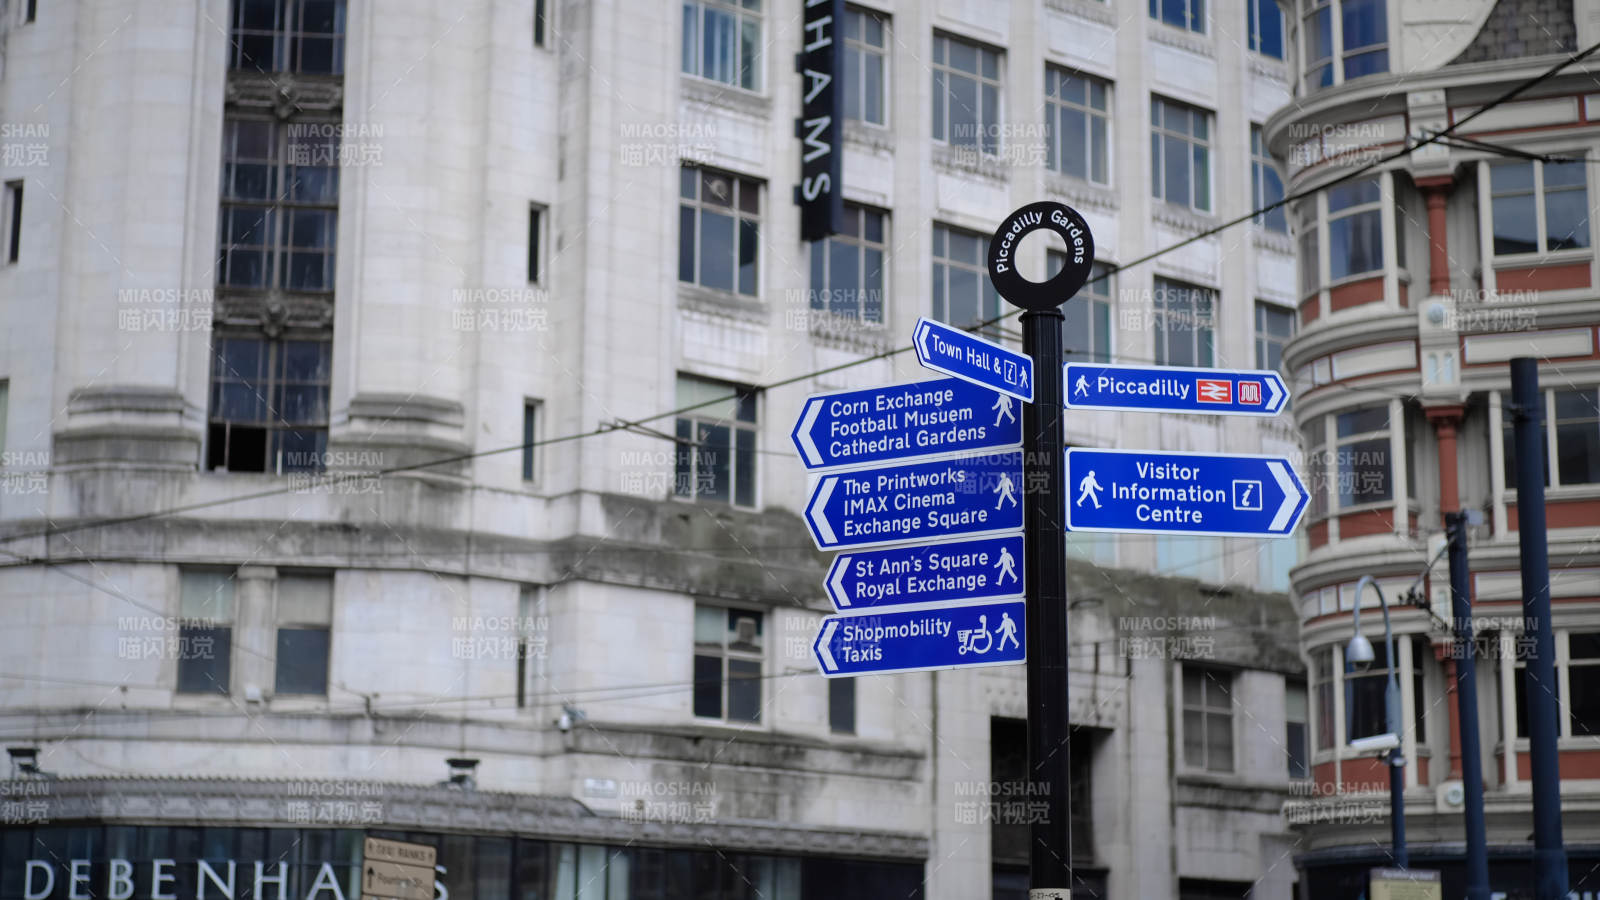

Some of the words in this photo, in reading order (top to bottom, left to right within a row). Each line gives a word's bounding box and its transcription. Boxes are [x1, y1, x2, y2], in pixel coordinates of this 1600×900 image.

[803, 0, 832, 201] HAMS
[996, 211, 1042, 273] Piccadilly
[1051, 210, 1084, 264] Gardens
[932, 333, 962, 361] Town
[966, 346, 990, 371] Hall
[993, 357, 1002, 376] &
[1097, 377, 1190, 400] Piccadilly
[830, 401, 869, 418] Corn
[876, 389, 954, 412] Exchange
[831, 416, 898, 438] Football
[904, 408, 973, 428] Musuem
[830, 432, 910, 457] Cathedral
[916, 426, 986, 446] Gardens
[844, 479, 871, 496] The
[878, 469, 966, 491] Printworks
[1136, 462, 1200, 481] Visitor
[844, 498, 888, 516] IMAX
[894, 492, 955, 510] Cinema
[1112, 482, 1226, 503] Information
[844, 515, 921, 537] Exchange
[928, 509, 988, 529] Square
[1136, 504, 1203, 524] Centre
[856, 561, 874, 578] St
[880, 556, 922, 575] Ann's
[929, 553, 989, 572] Square
[856, 581, 901, 600] Royal
[908, 574, 987, 593] Exchange
[843, 618, 951, 642] Shopmobility
[843, 646, 883, 663] Taxis
